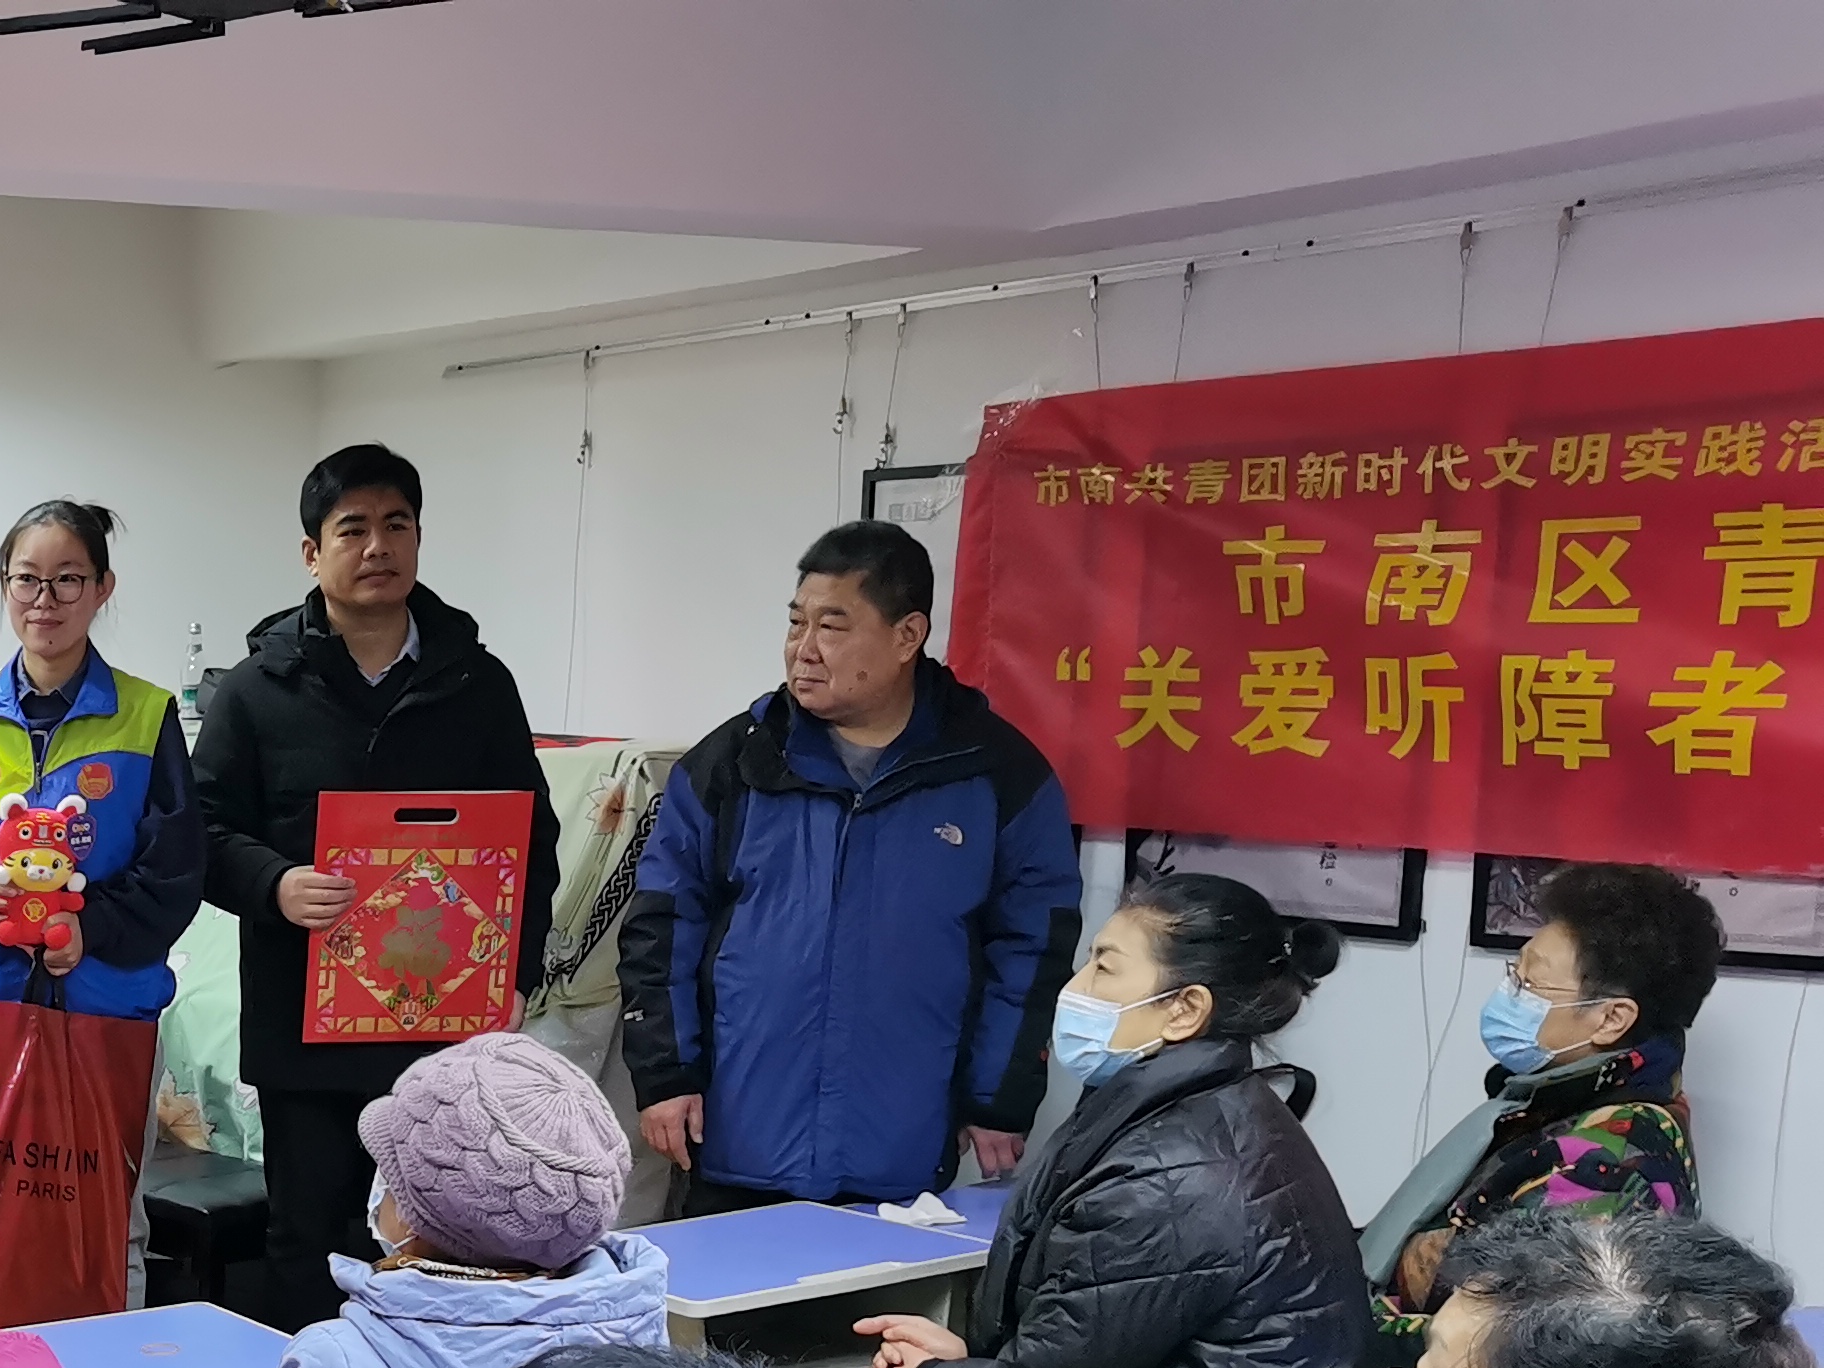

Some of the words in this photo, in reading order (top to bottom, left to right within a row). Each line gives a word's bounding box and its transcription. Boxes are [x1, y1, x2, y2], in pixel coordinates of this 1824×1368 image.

[1222, 502, 1824, 627] 市南区青
[16, 1180, 77, 1202] PARIS
